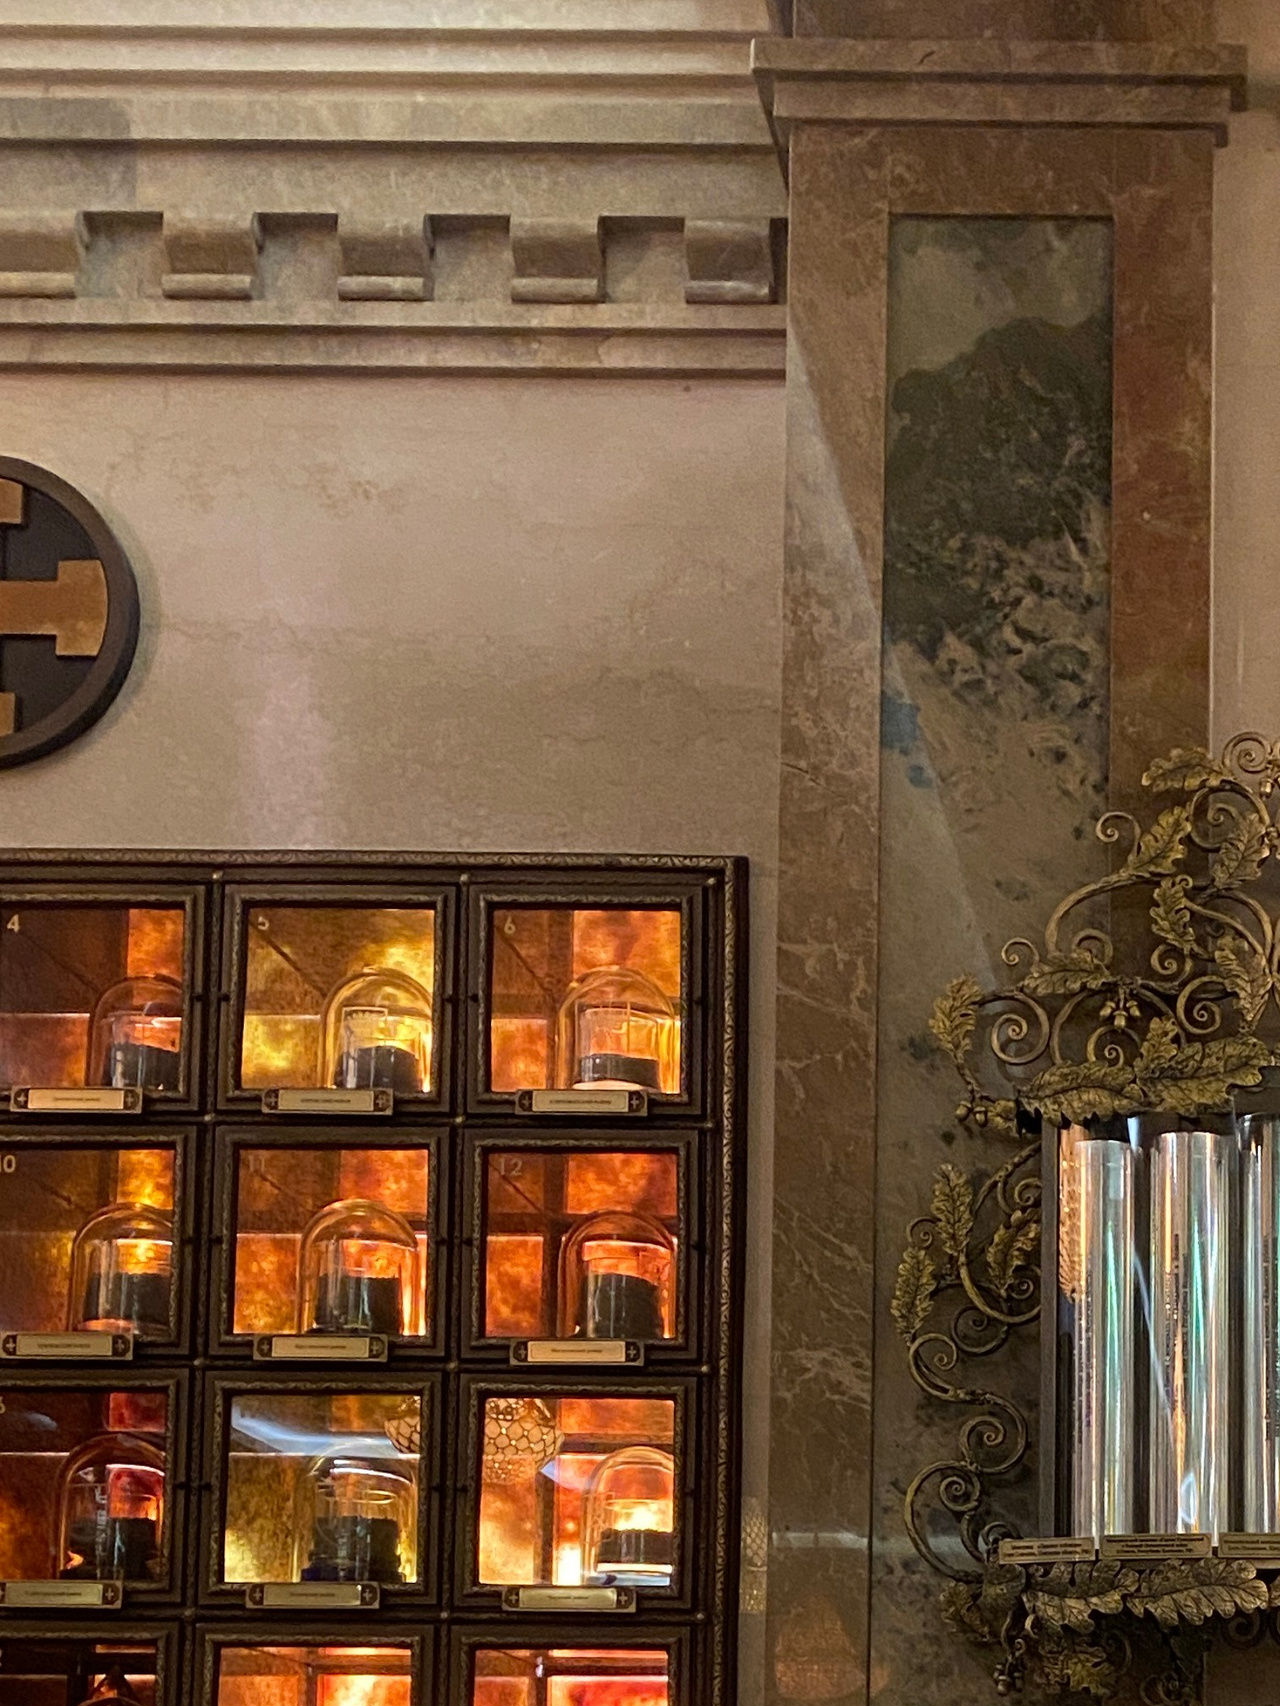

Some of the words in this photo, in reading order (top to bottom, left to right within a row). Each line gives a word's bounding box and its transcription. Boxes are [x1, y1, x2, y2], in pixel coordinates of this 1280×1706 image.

[6, 914, 20, 932] 4
[503, 917, 517, 934] 6
[0, 1155, 17, 1173] 0
[497, 1158, 523, 1176] 12
